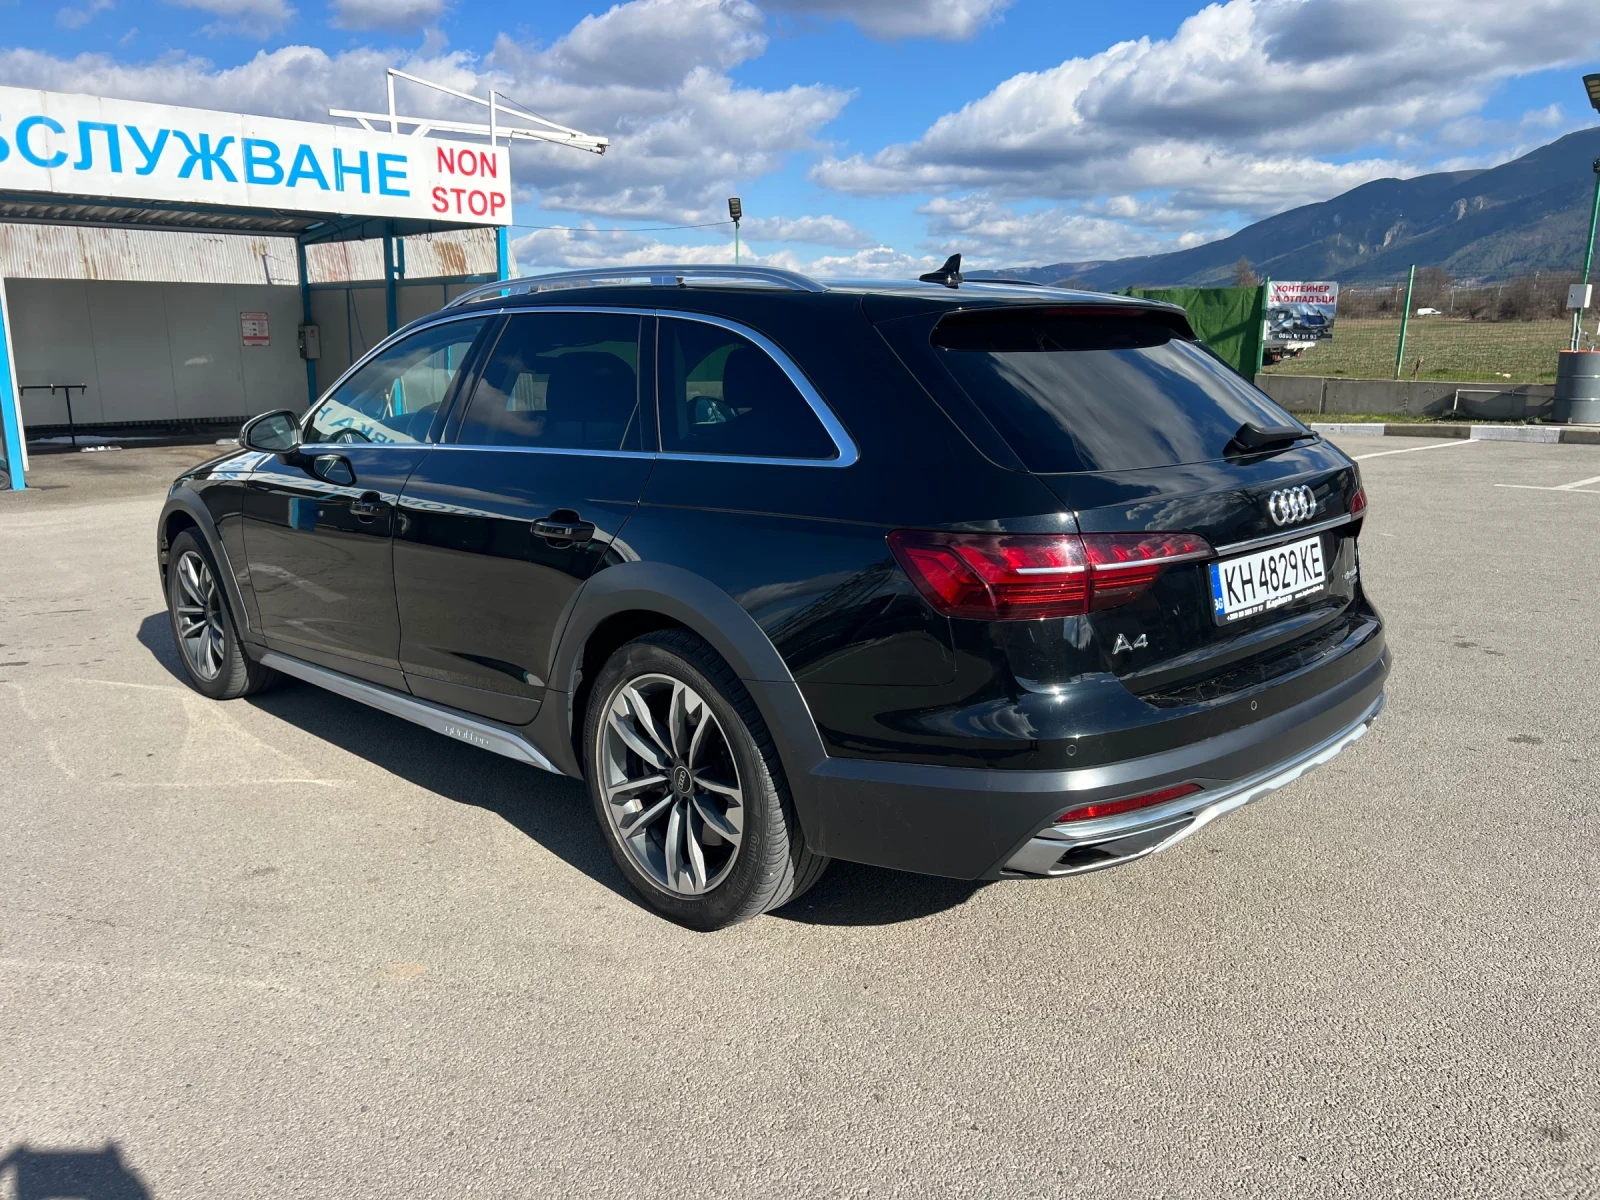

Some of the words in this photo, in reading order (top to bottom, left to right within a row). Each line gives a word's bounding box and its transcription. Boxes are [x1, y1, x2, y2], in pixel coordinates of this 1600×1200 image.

[0, 112, 411, 198] СЛУЖВАНЕ
[436, 146, 498, 180] NON
[431, 186, 507, 218] STOP
[1276, 284, 1330, 292] КОНТЕЙНЕР
[1283, 296, 1335, 304] ОТПАДЪЦИ
[1259, 549, 1298, 595] 4829
[1111, 632, 1149, 655] A4
